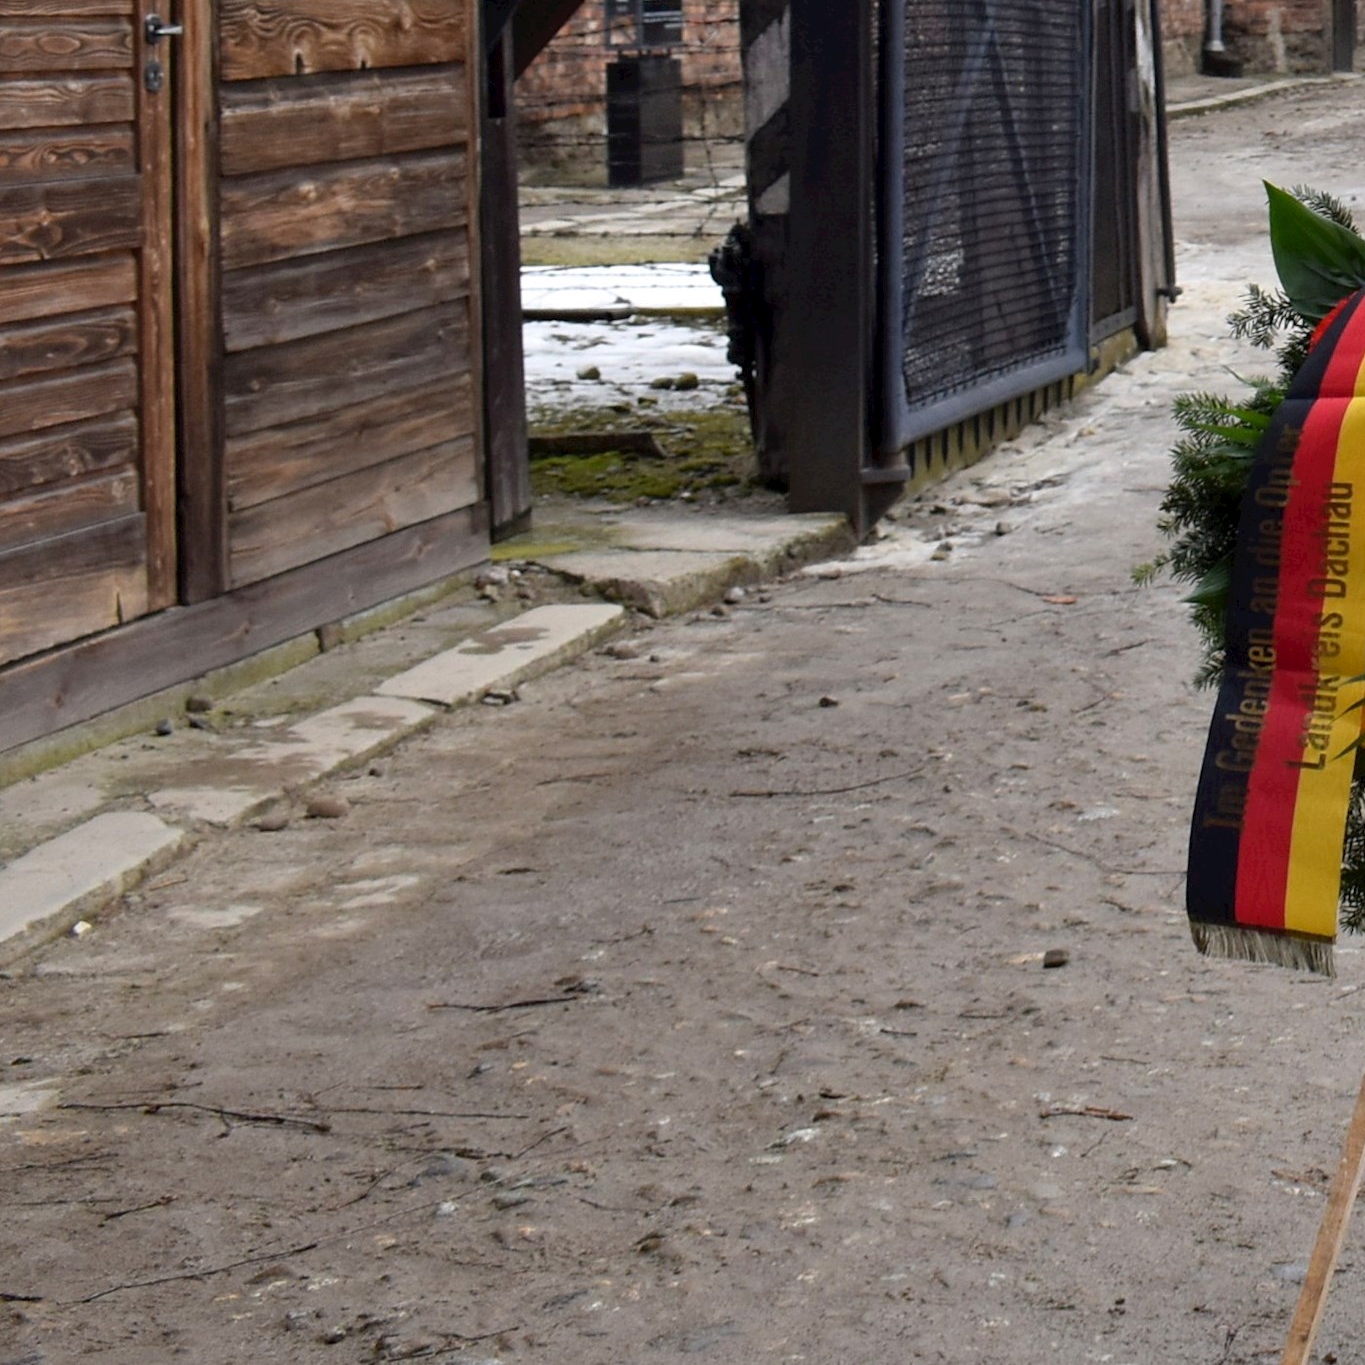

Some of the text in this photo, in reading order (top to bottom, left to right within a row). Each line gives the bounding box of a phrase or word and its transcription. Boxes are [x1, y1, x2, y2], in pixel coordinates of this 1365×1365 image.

[1246, 519, 1283, 567] die
[1248, 576, 1279, 616] an
[1281, 482, 1353, 772] Landkreis Dachau
[1214, 627, 1277, 774] Gedenken
[1203, 785, 1246, 831] Im
